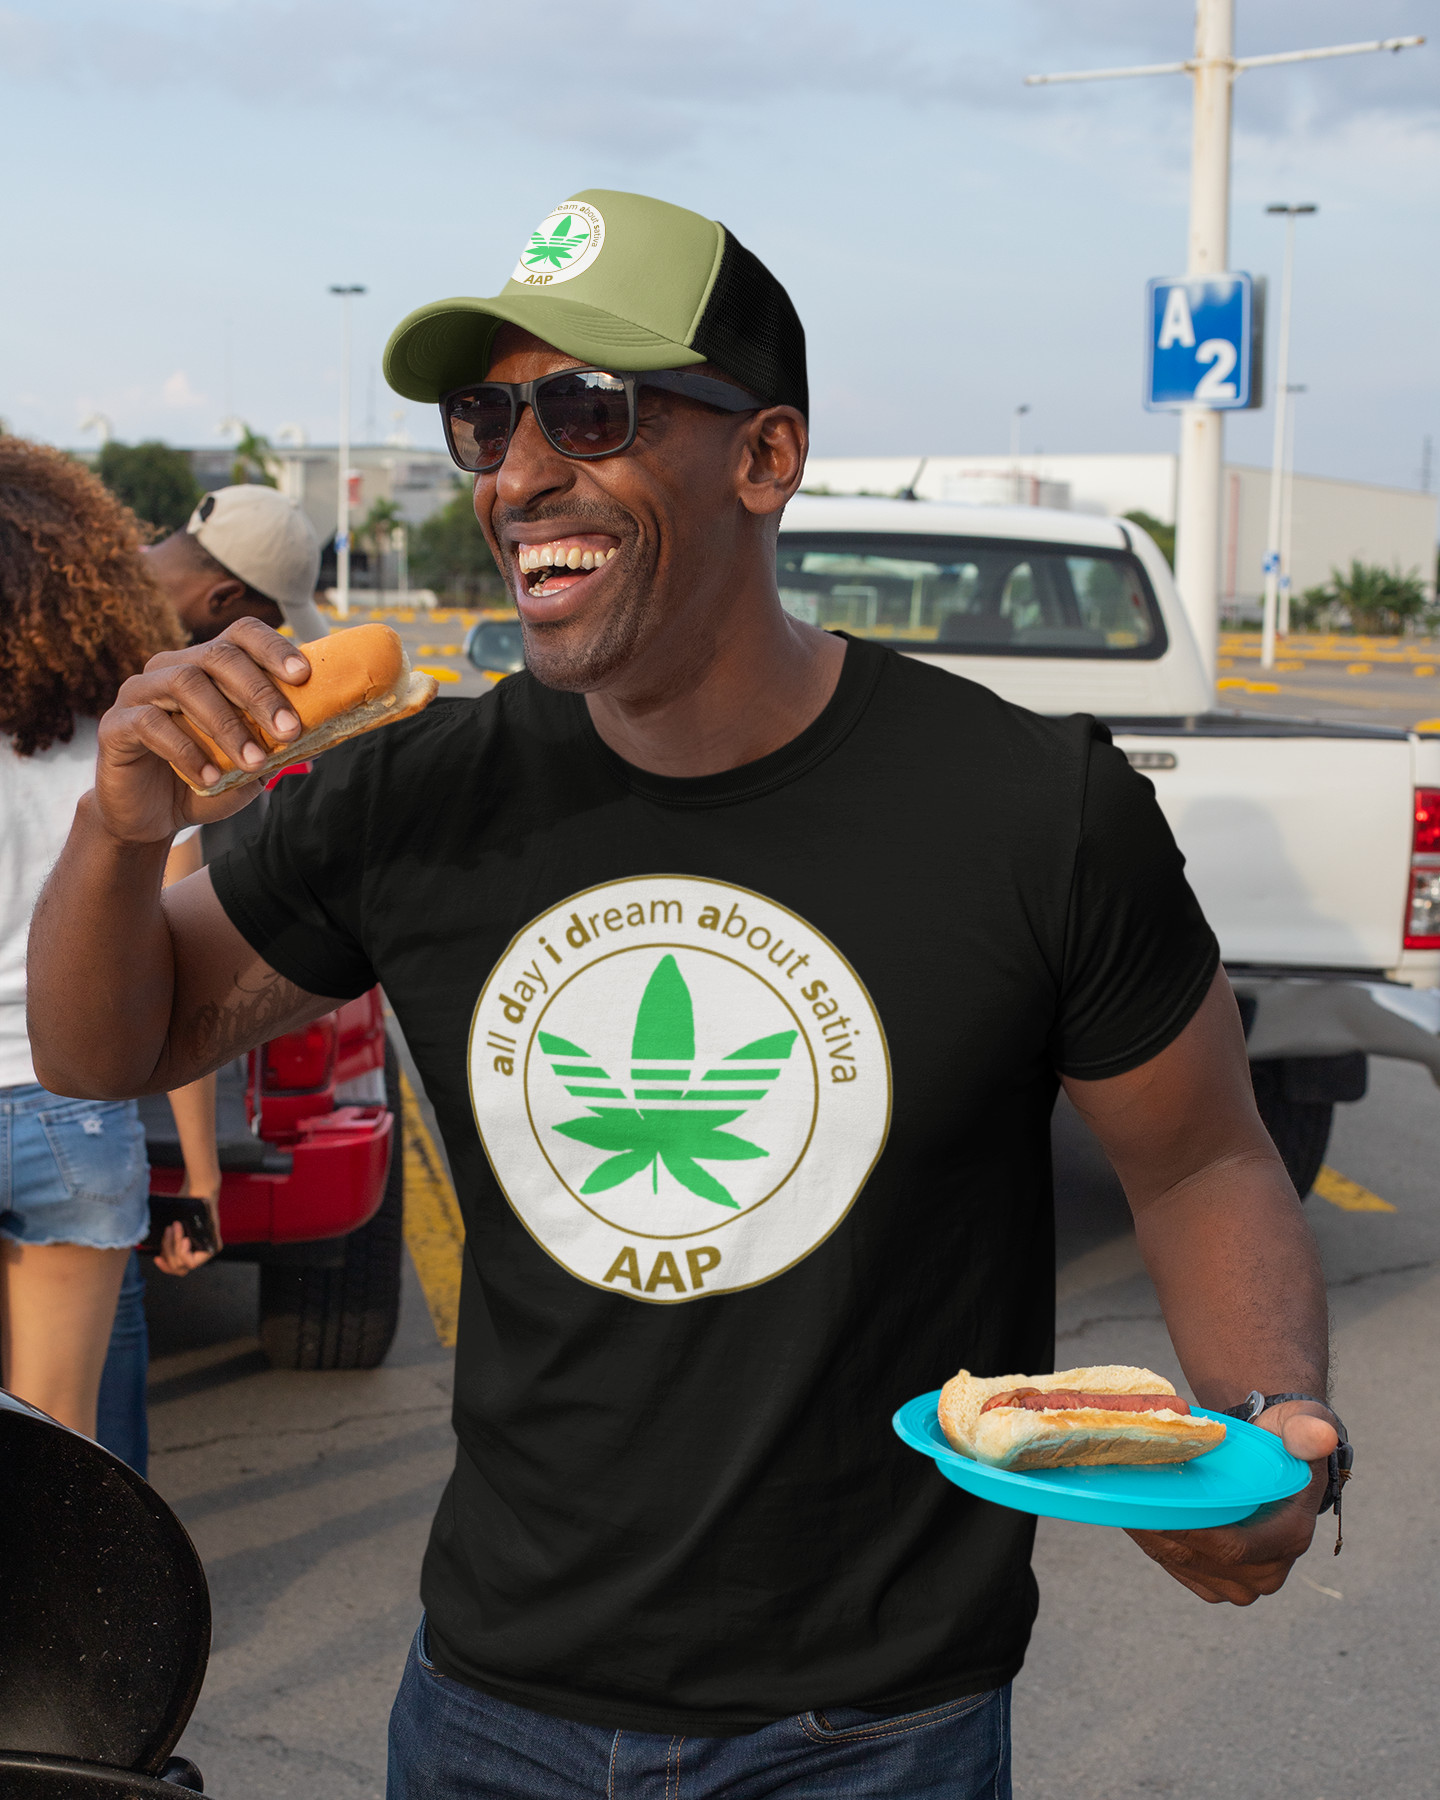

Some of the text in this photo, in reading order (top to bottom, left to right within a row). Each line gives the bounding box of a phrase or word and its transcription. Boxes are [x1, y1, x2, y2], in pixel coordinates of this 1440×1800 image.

[579, 206, 599, 224] about
[591, 225, 602, 248] sativa
[523, 274, 553, 285] AAP
[1157, 286, 1196, 350] A
[1193, 338, 1237, 400] 2
[487, 900, 861, 1084] all day i dream about sativa
[602, 1246, 722, 1293] AAP
